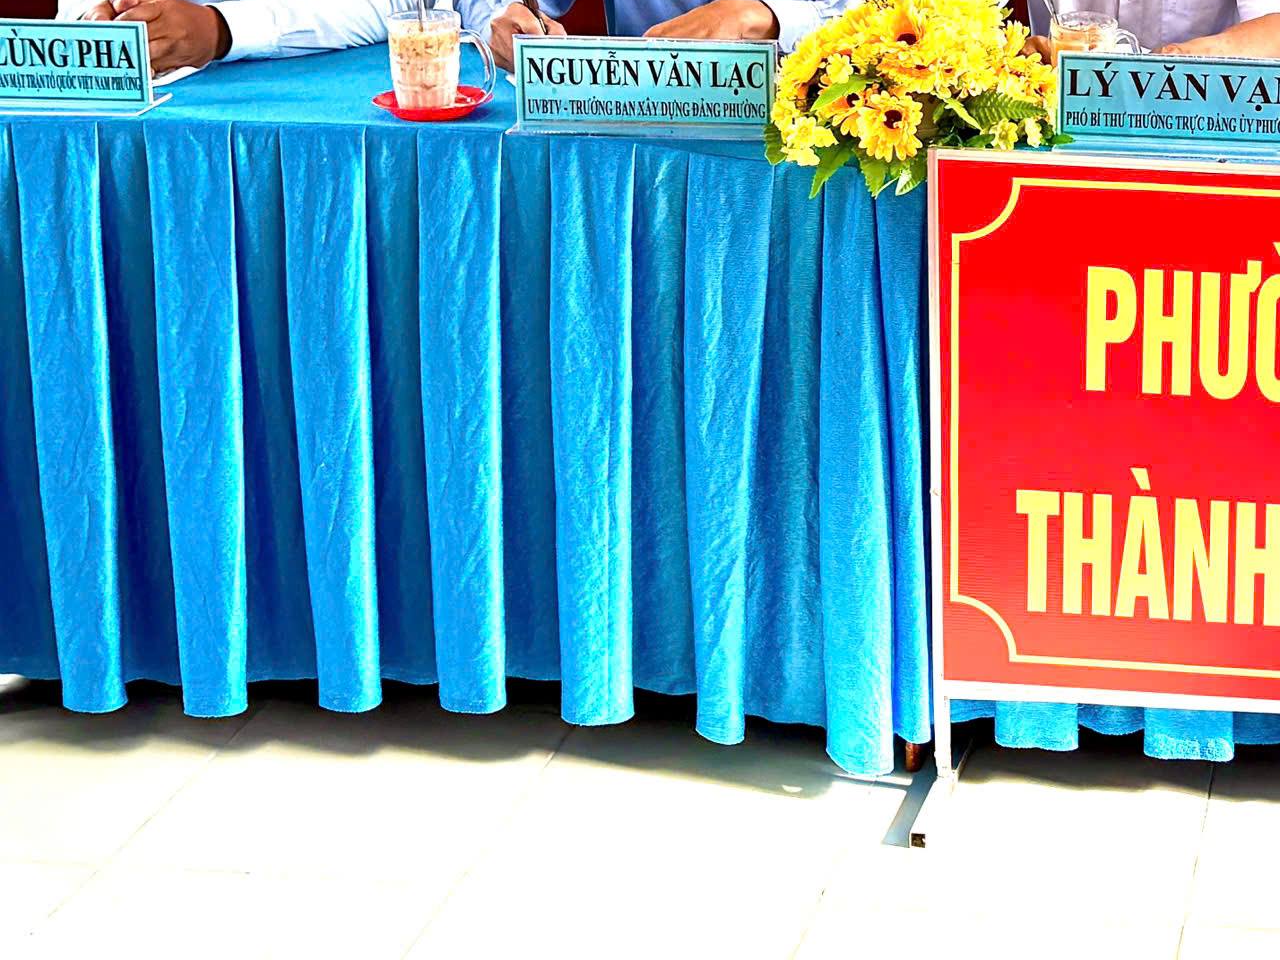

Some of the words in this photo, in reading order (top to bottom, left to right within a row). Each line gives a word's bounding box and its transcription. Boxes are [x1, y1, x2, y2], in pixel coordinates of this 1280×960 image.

[75, 39, 136, 70] PHA
[527, 50, 641, 88] NGUYỄN
[647, 53, 703, 89] VĂN
[710, 61, 766, 96] LẠC
[1066, 61, 1119, 98] LÝ
[1128, 64, 1210, 102] VĂN
[528, 98, 561, 115] UVBTV
[569, 96, 613, 116] TRƯỞNG
[615, 100, 636, 116] BAN
[637, 96, 659, 117] XÂY
[661, 99, 690, 120] DỰNG
[692, 97, 720, 118] ĐẢNG
[723, 98, 766, 119] PHƯỜNG
[1066, 107, 1088, 127] PHÓ
[1090, 108, 1101, 127] BÍ
[1103, 111, 1127, 128] THƯ
[1128, 109, 1173, 130] THƯỜNG
[1175, 114, 1205, 134] TRỰC
[1207, 112, 1237, 133] ĐẢNG
[1239, 113, 1256, 134] ỦY
